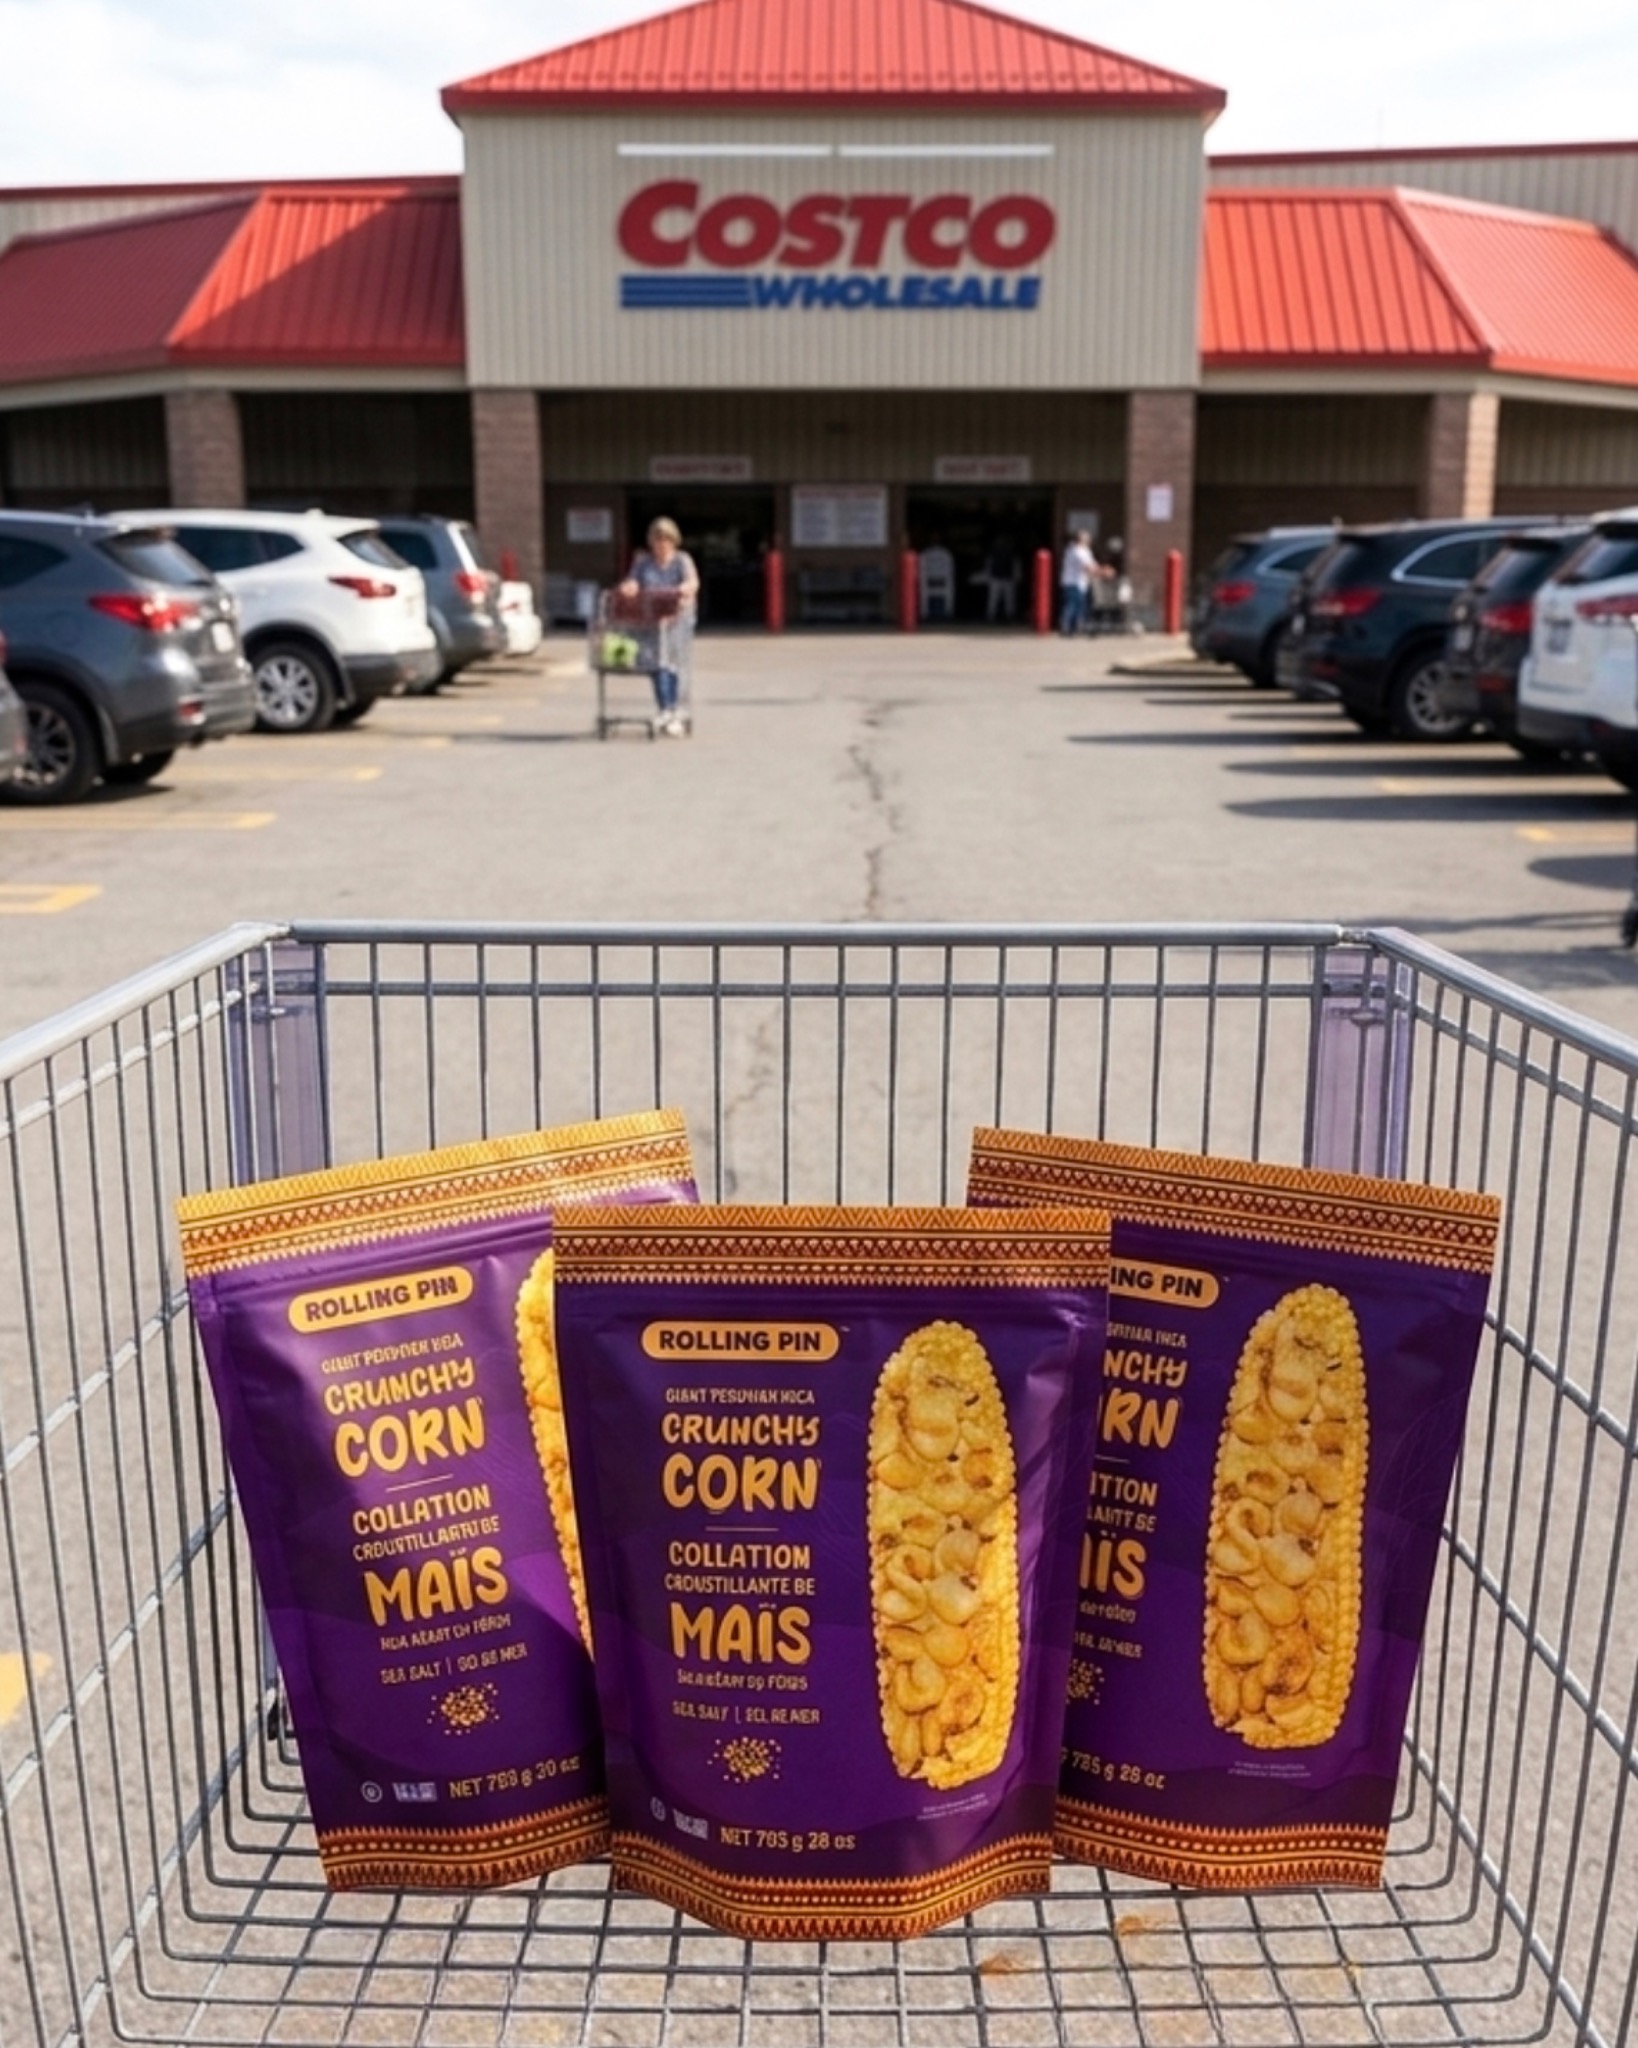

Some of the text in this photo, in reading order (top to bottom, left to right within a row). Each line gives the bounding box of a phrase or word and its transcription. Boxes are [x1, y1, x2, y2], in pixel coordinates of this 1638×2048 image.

[618, 179, 1055, 269] COSTCO
[748, 276, 1041, 309] WHOLESALE
[305, 1276, 459, 1322] ROLLING PIN
[1161, 1274, 1202, 1298] PIN
[659, 1330, 821, 1351] ROLLING PIN
[324, 1357, 475, 1415] CRUNCHY
[335, 1397, 485, 1478] CORN
[1098, 1387, 1180, 1449] RN
[662, 1453, 820, 1513] CORN
[353, 1484, 491, 1535] COLLATION
[669, 1541, 811, 1569] COLLATION
[364, 1546, 508, 1627] MAÏS
[664, 1573, 791, 1595] CROUSTILLANTE
[670, 1602, 812, 1665] MAÏS
[449, 1776, 483, 1799] NET
[720, 1826, 752, 1846] NET
[792, 1835, 803, 1852] g
[808, 1832, 829, 1849] 28
